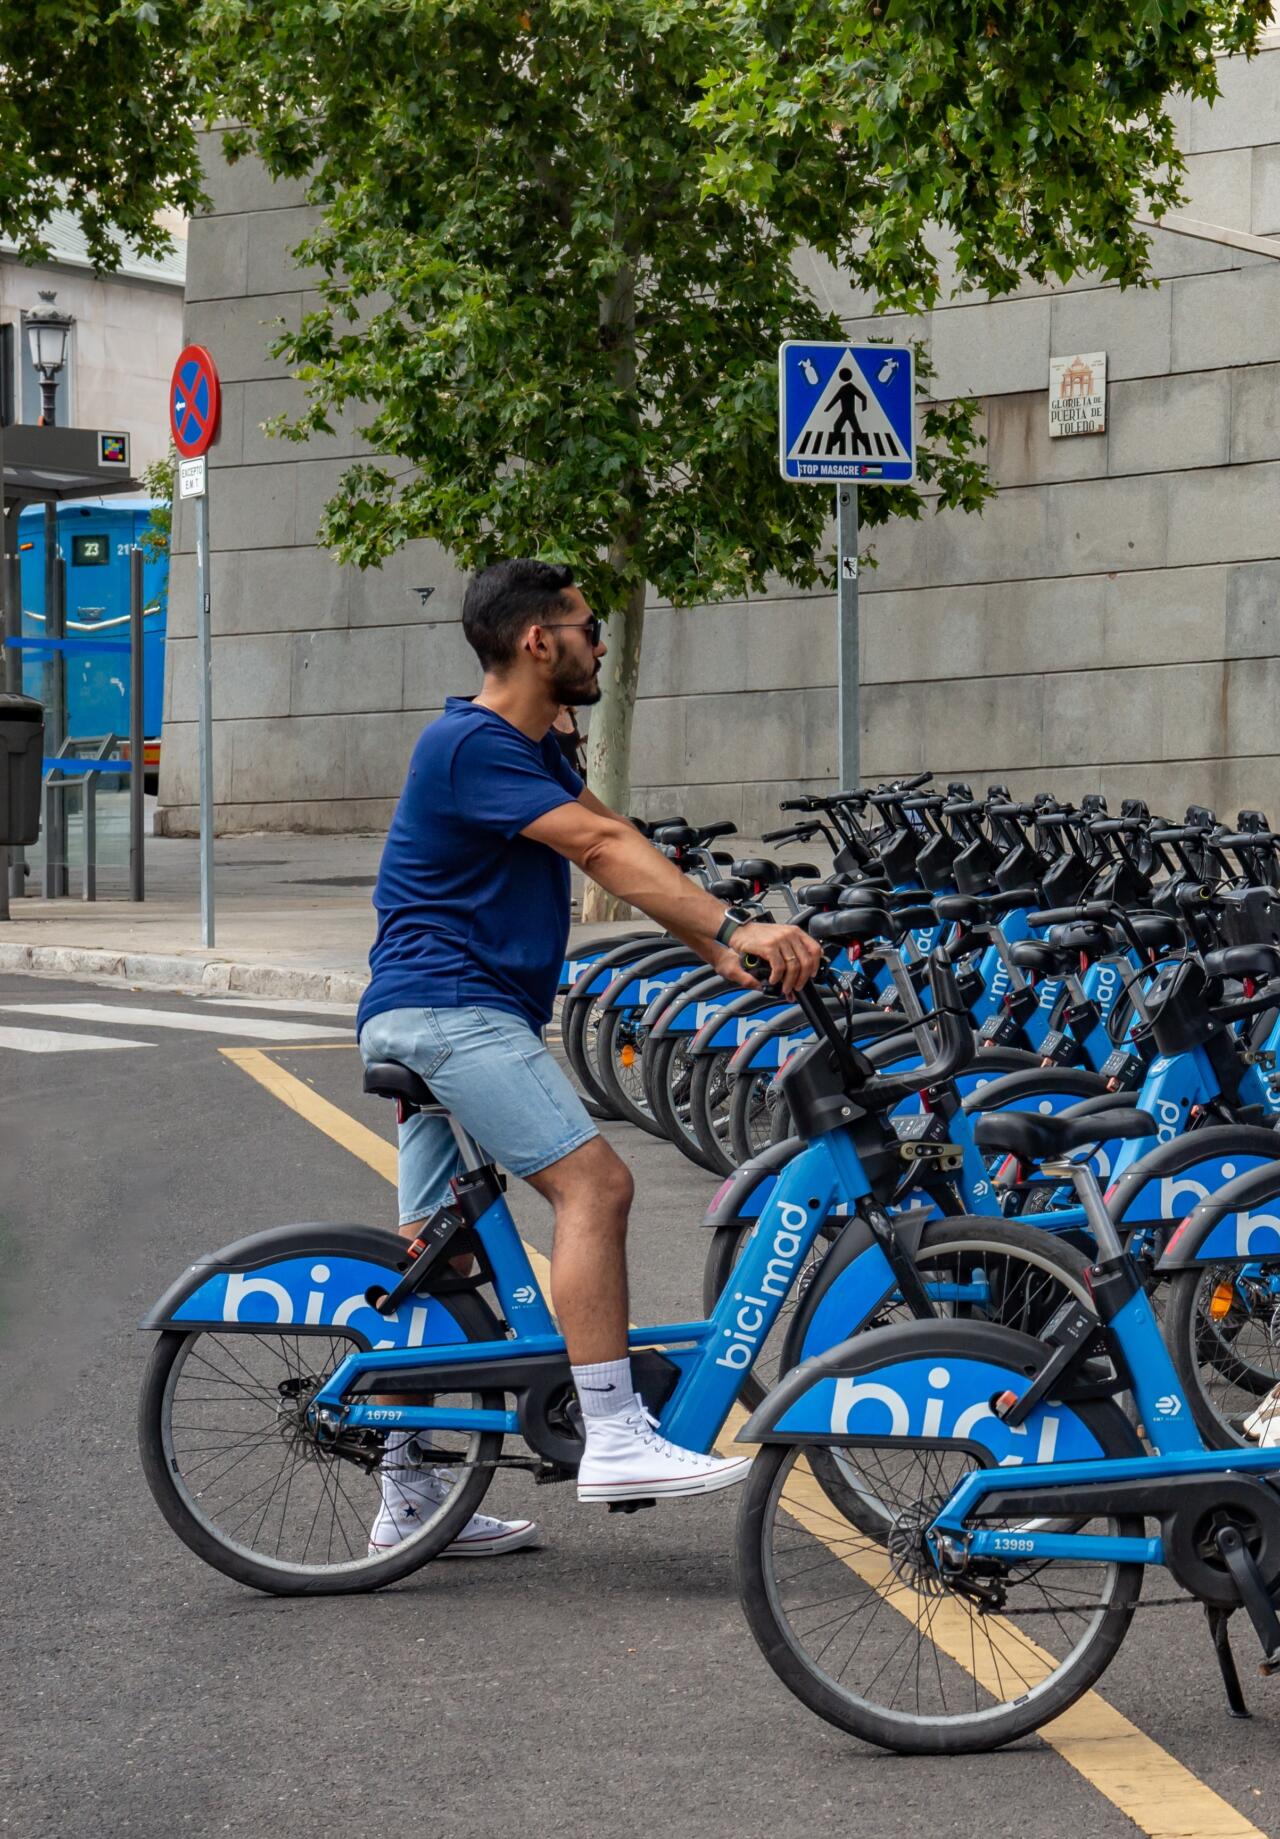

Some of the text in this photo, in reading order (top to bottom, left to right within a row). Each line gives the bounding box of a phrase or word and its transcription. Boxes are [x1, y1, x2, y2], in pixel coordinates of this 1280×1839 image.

[1052, 397, 1091, 409] GLORIETA
[1051, 407, 1102, 422] PUERTA DE
[1060, 420, 1095, 435] TOLEDO
[182, 465, 202, 478] EXCEPTO
[799, 464, 860, 476] STOP MASACRE
[84, 542, 99, 556] 23
[716, 1201, 807, 1370] bici mad
[367, 1410, 402, 1421] 16797
[994, 1539, 1034, 1551] 13989
